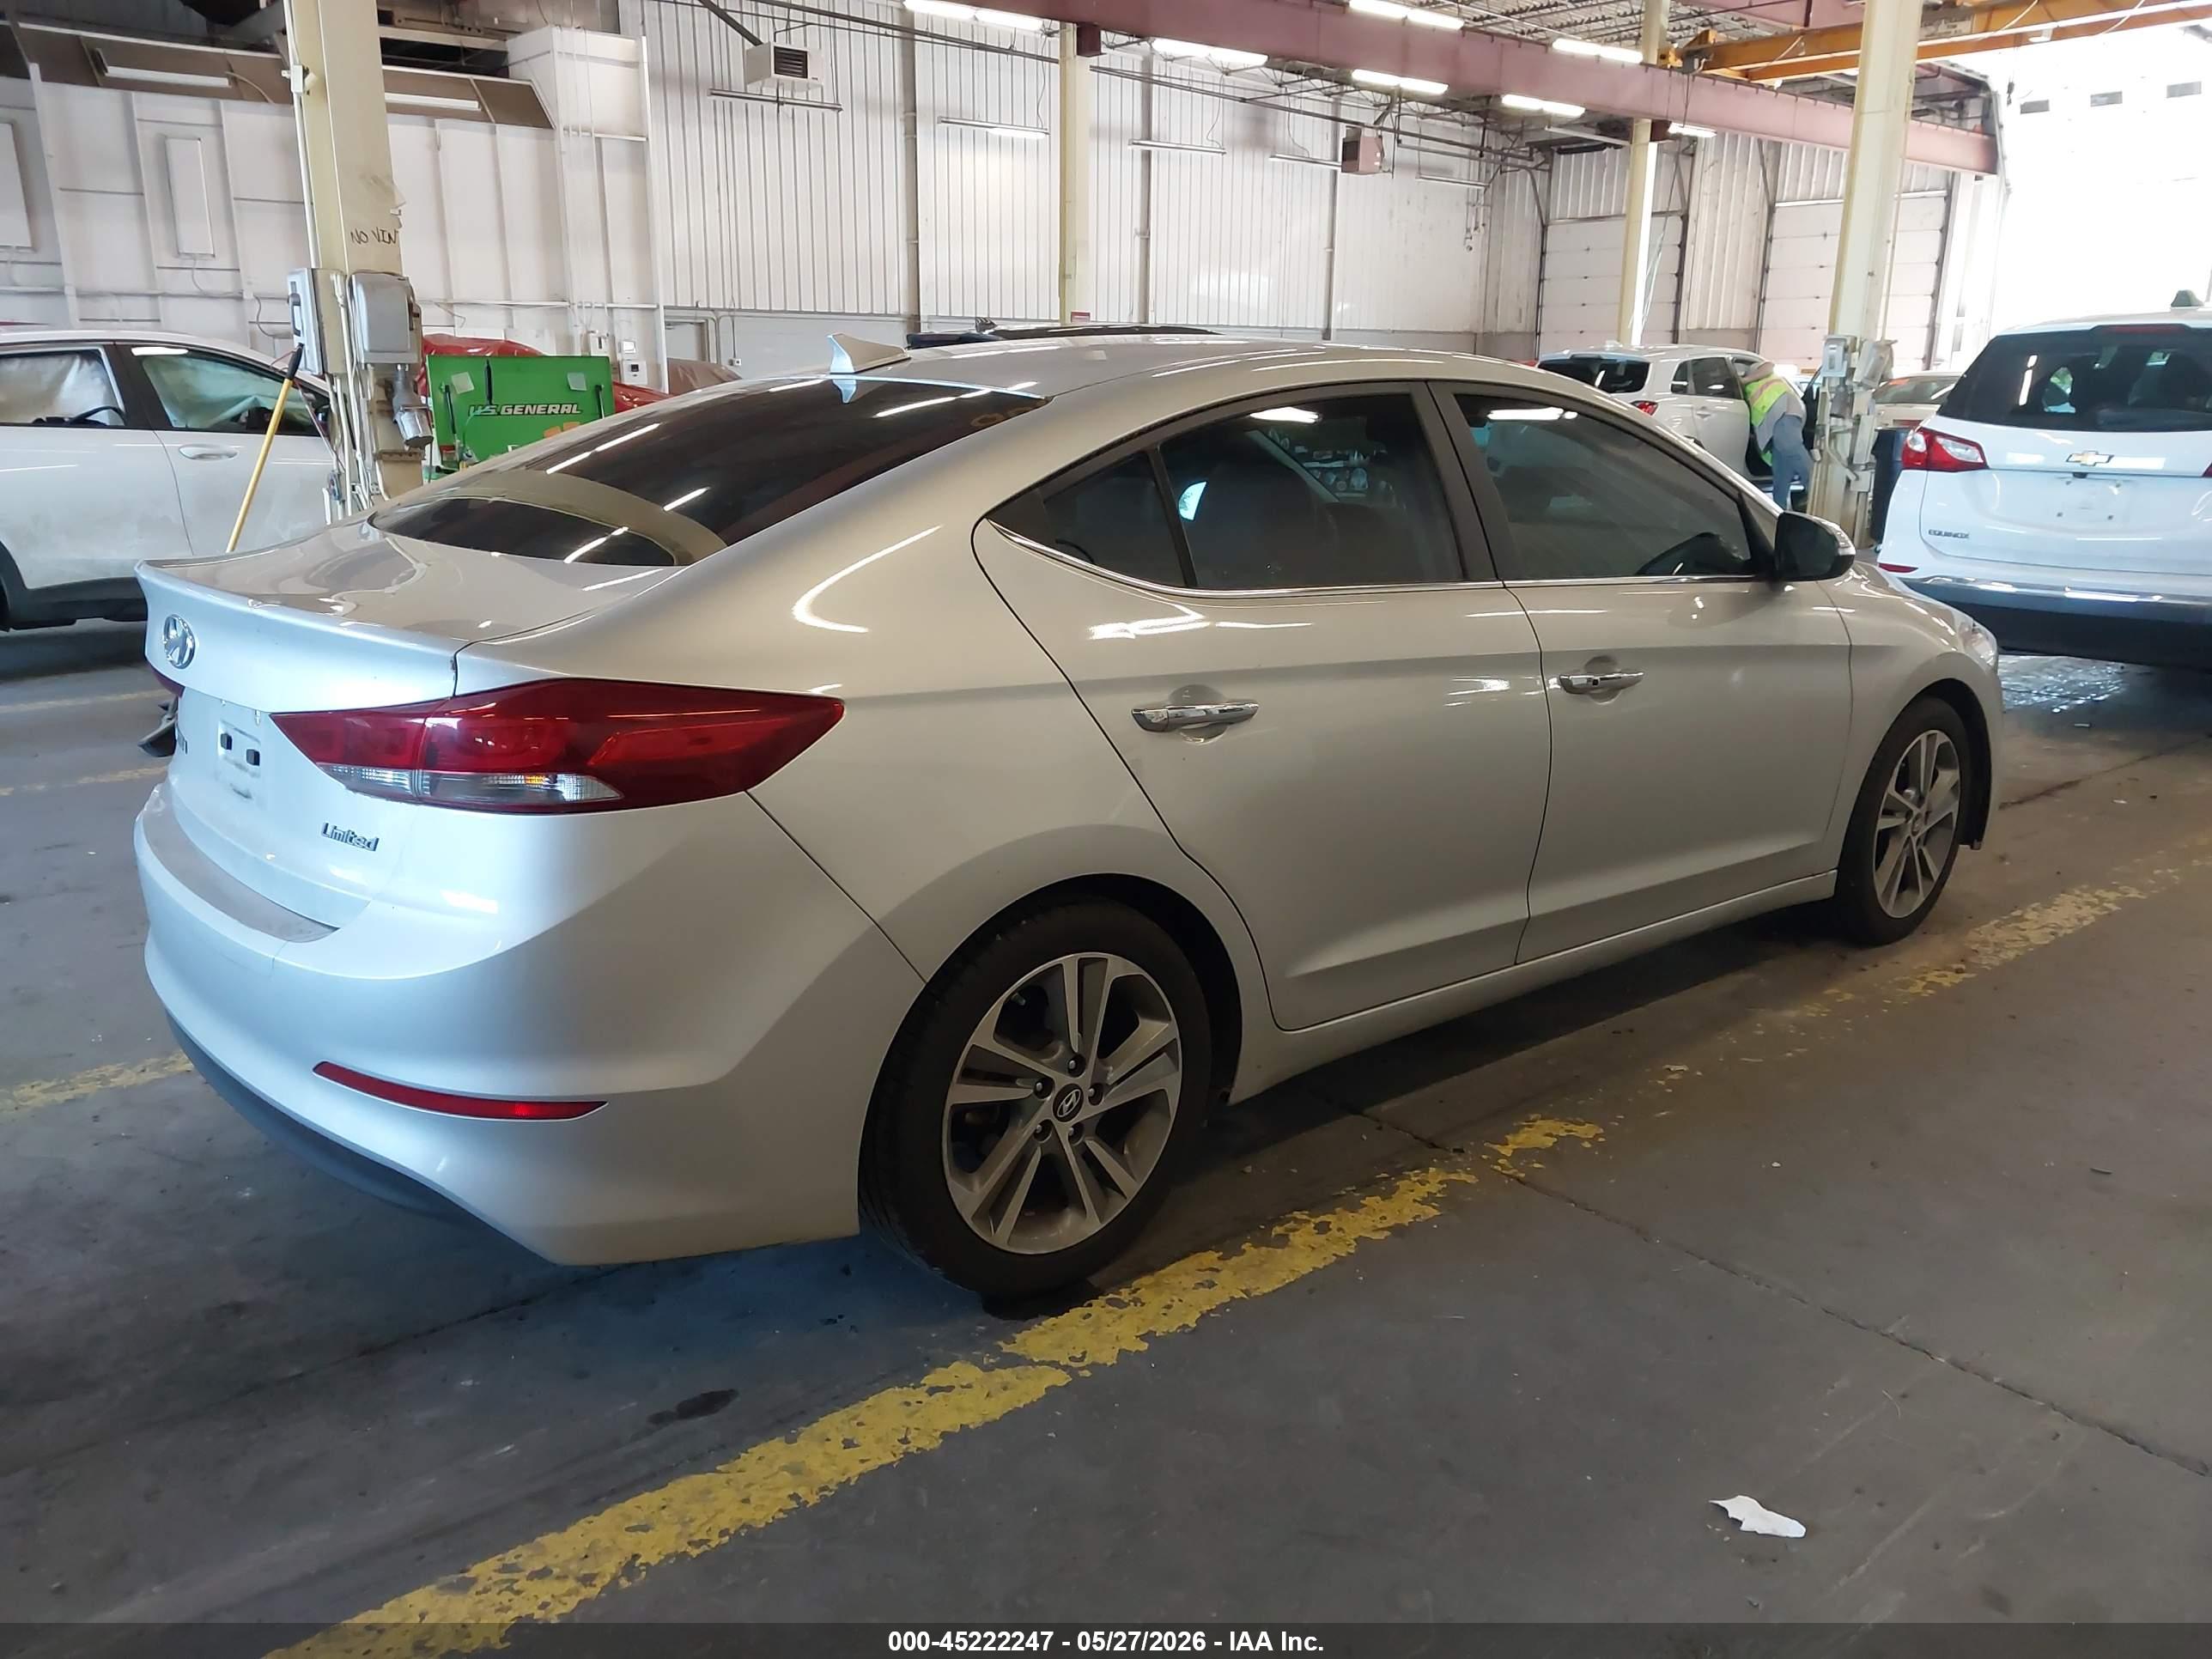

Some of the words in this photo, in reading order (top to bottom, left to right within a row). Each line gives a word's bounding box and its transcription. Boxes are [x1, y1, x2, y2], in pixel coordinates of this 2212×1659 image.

[349, 228, 368, 244] NO
[371, 227, 398, 244] VIN
[500, 404, 581, 415] GENERAL
[321, 822, 380, 852] Limited
